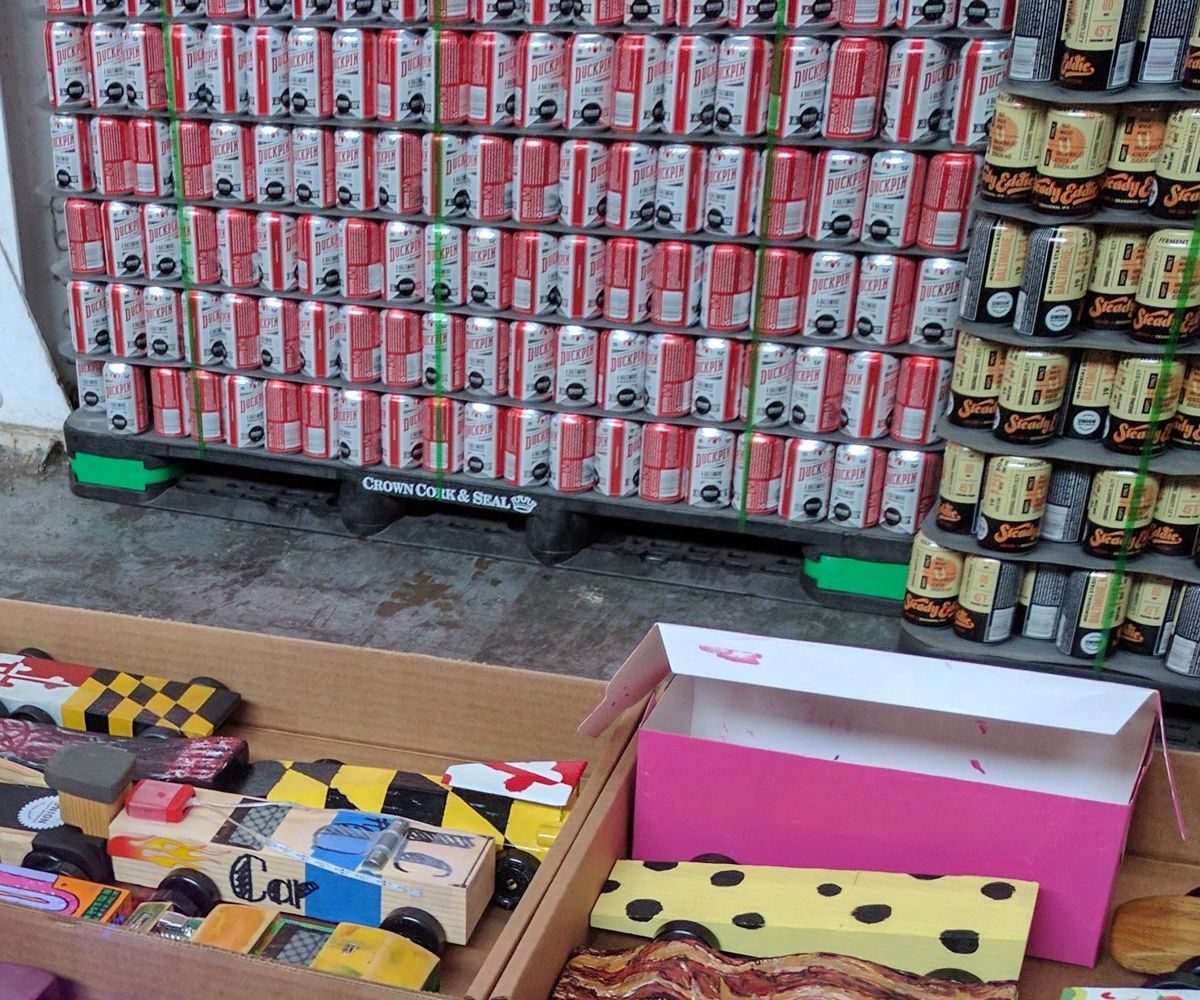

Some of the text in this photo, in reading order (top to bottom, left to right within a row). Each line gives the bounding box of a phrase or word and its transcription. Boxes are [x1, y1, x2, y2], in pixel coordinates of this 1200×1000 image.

[362, 476, 511, 510] CROWN CORK & SEAL
